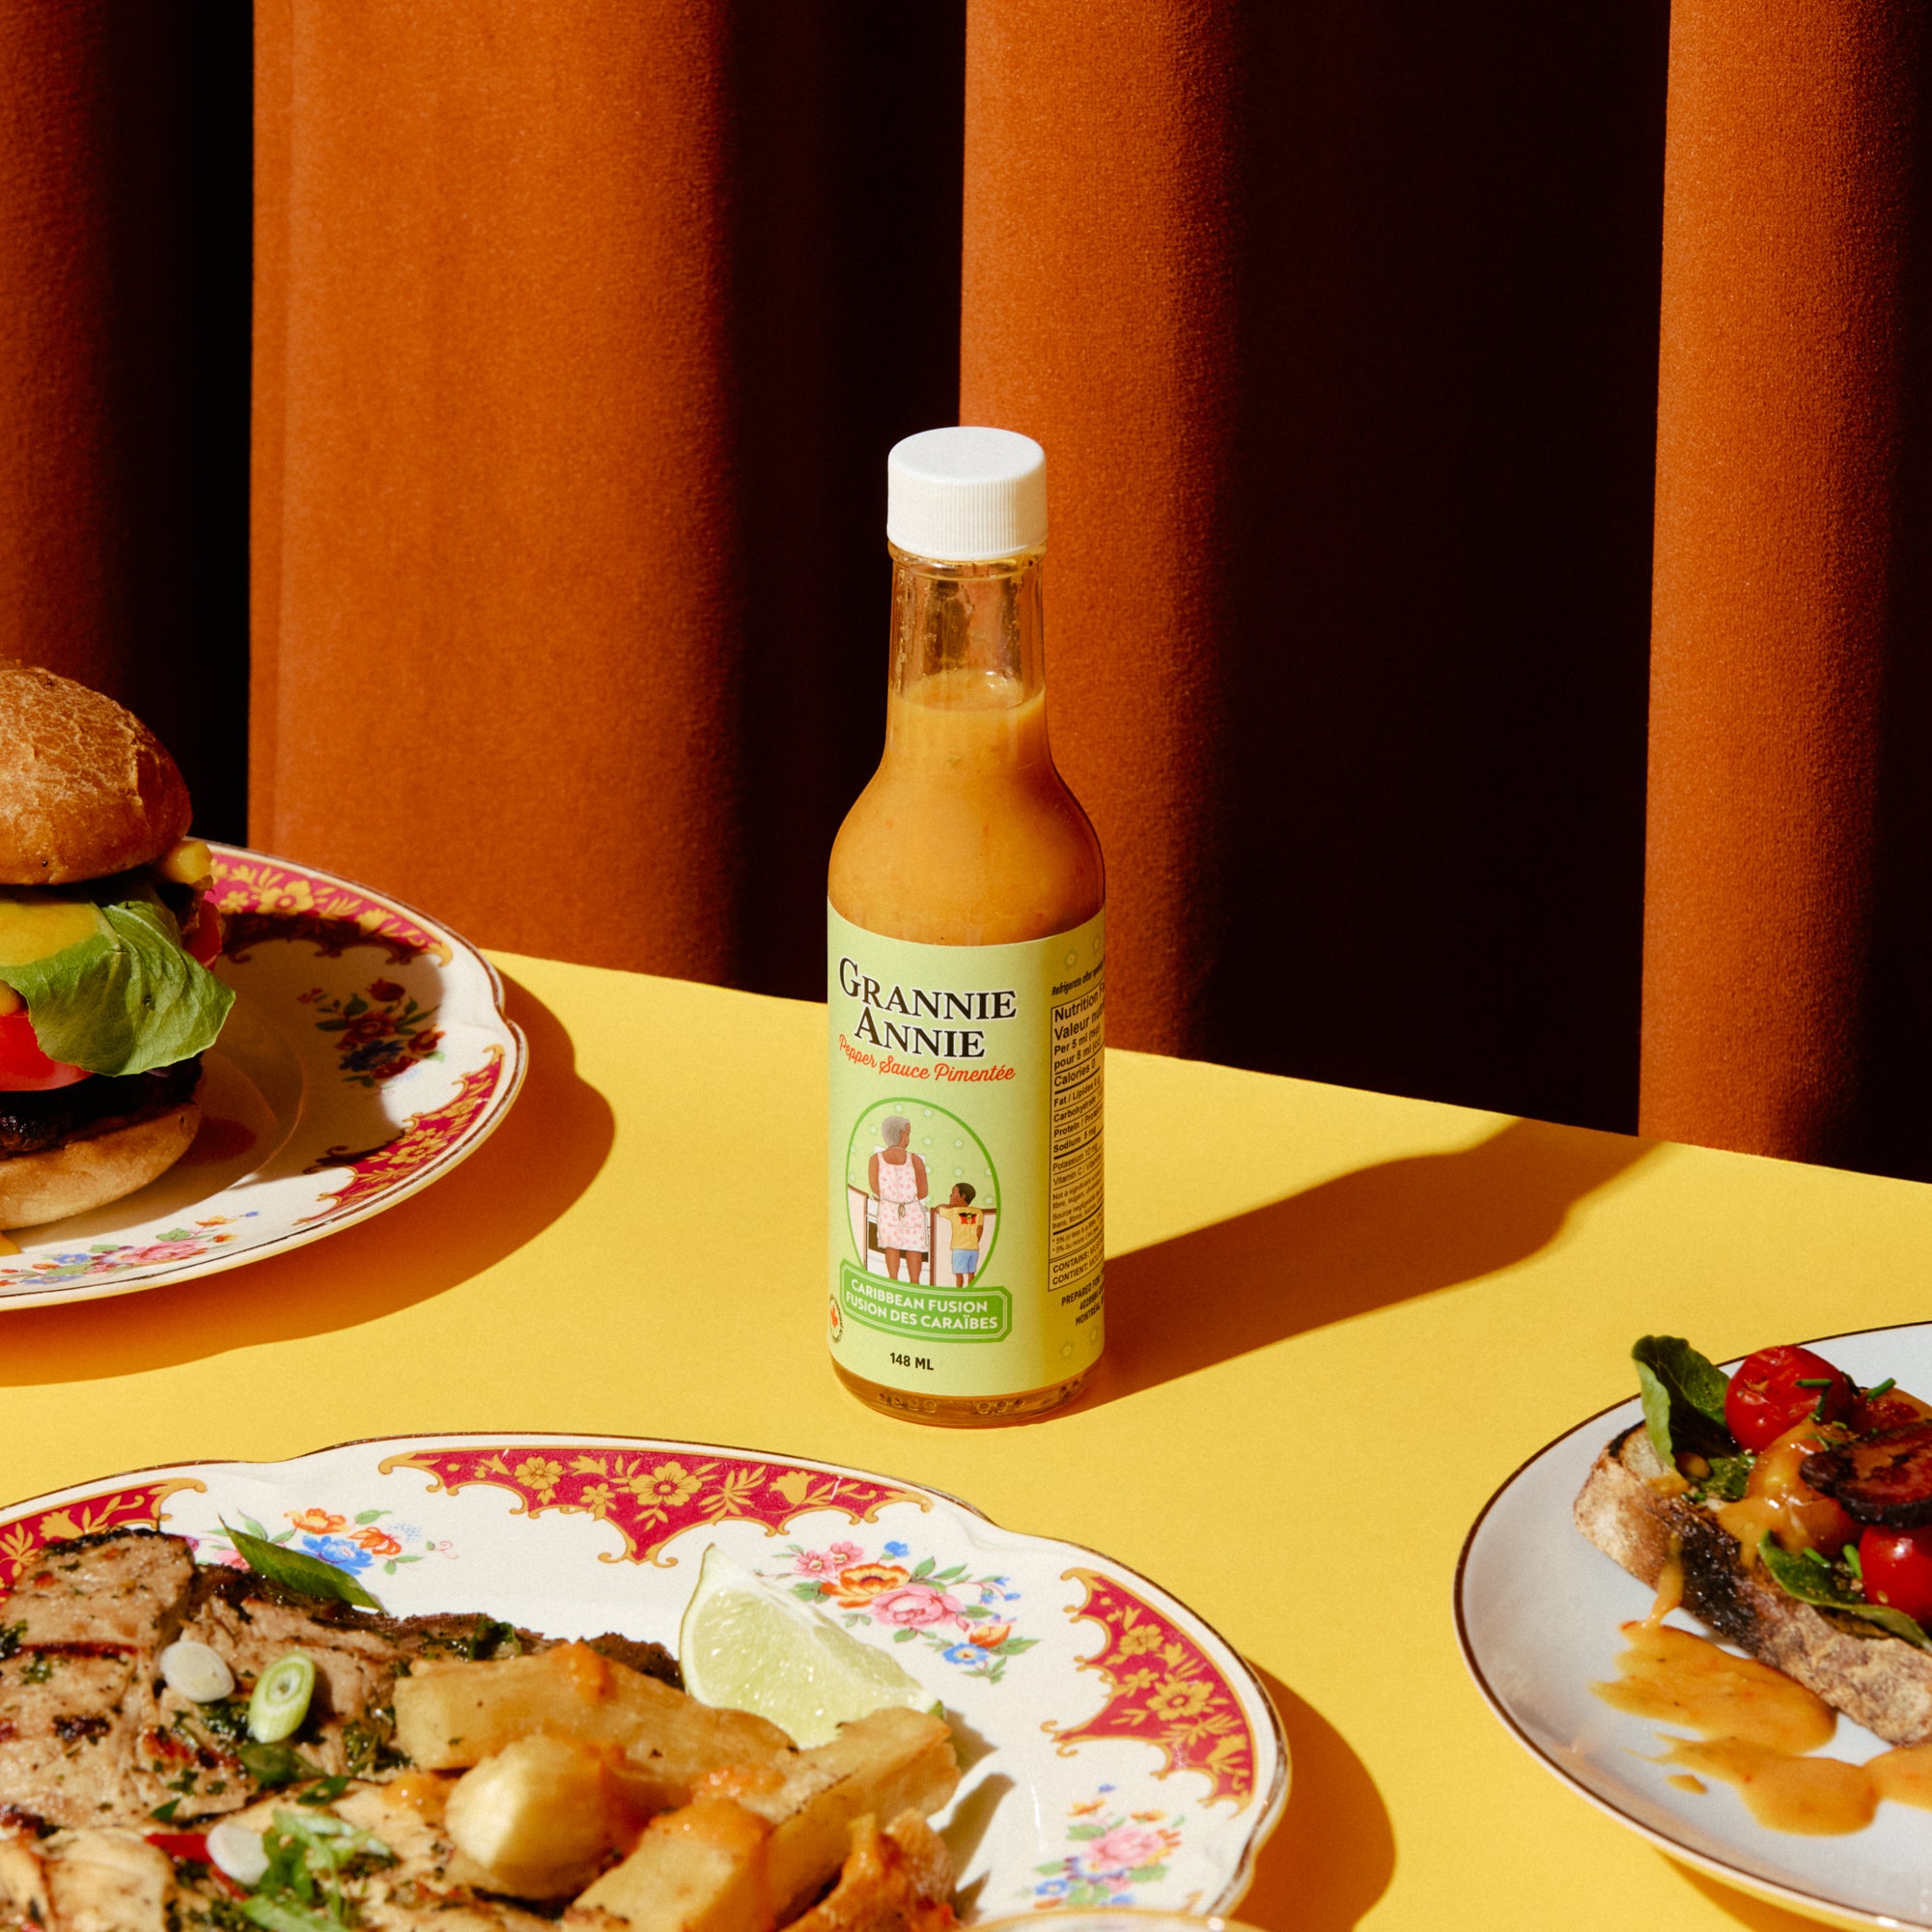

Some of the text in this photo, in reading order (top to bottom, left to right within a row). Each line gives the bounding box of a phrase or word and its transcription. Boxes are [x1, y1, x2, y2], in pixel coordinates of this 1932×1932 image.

[838, 957, 1018, 1022] GRANNIE
[1051, 976, 1082, 996] Refrigerate
[1054, 992, 1098, 1023] Nutrition
[854, 1005, 986, 1059] ANNIE
[1053, 1016, 1090, 1042] Valeur
[1054, 1043, 1071, 1056] Per
[1072, 1038, 1078, 1050] 5
[1078, 1032, 1088, 1046] ml
[838, 1033, 1017, 1082] Pepper Sauce Pimentée
[1054, 1055, 1075, 1072] pour
[1077, 1049, 1081, 1060] 5
[1082, 1043, 1092, 1056] ml
[1054, 1058, 1096, 1087] Calories 0
[1054, 1095, 1067, 1107] Fat
[1073, 1082, 1094, 1101] Lipides
[1053, 1095, 1097, 1123] Carbohydrate
[1053, 1121, 1080, 1138] Protein
[1052, 1137, 1081, 1153] Sodium
[1052, 1171, 1077, 1187] Vitamin
[1078, 1166, 1082, 1176] C
[1052, 1250, 1090, 1274] CONTAINS:
[1052, 1262, 1089, 1285] CONTIENT:
[851, 1278, 988, 1313] CARIBBEAN FUSION
[1061, 1282, 1092, 1306] PREPARED
[845, 1291, 998, 1330] FUSION DES CARAÏBES
[889, 1352, 934, 1371] 148 ML
